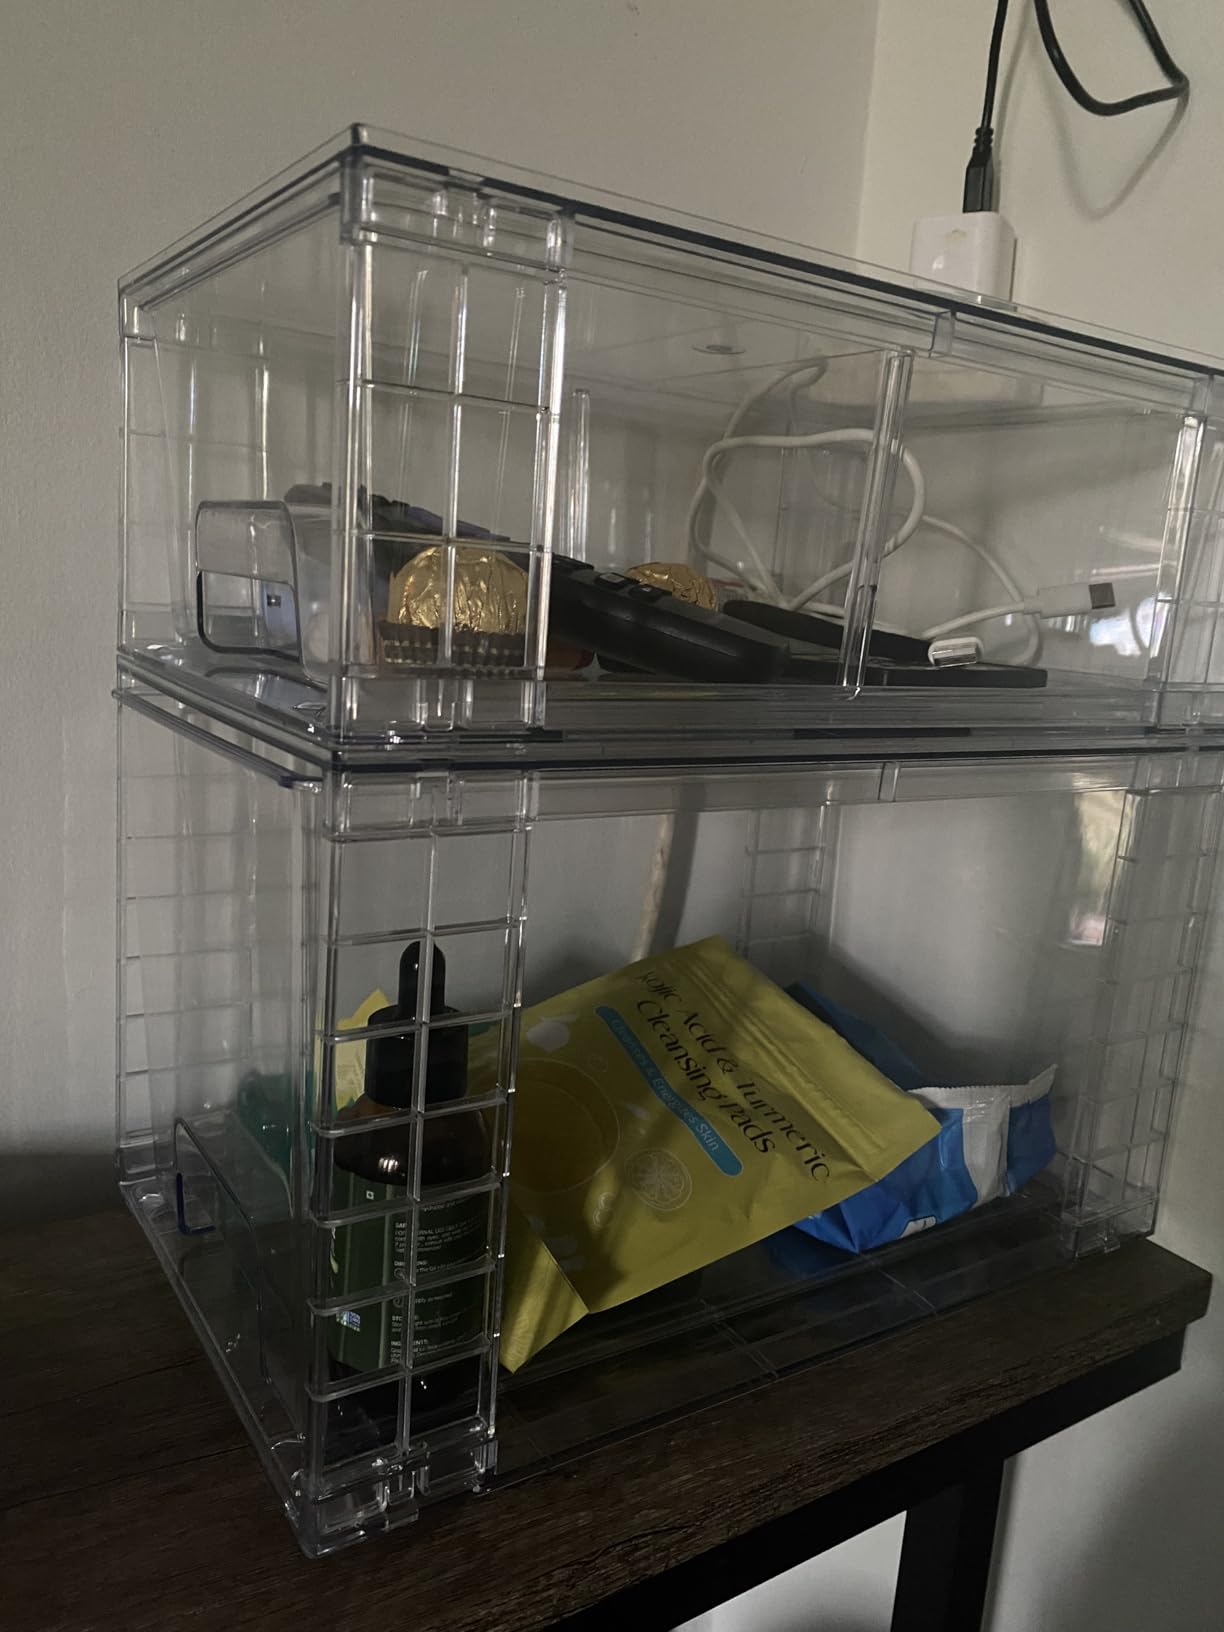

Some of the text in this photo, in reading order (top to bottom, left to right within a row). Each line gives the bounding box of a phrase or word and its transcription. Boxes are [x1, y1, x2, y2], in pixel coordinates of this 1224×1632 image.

[636, 999, 777, 1154] Cleansing Pads
[675, 1009, 728, 1054] Acid
[715, 1056, 739, 1075] &
[736, 1081, 831, 1184] Turmeric
[698, 1122, 720, 1152] Skin
